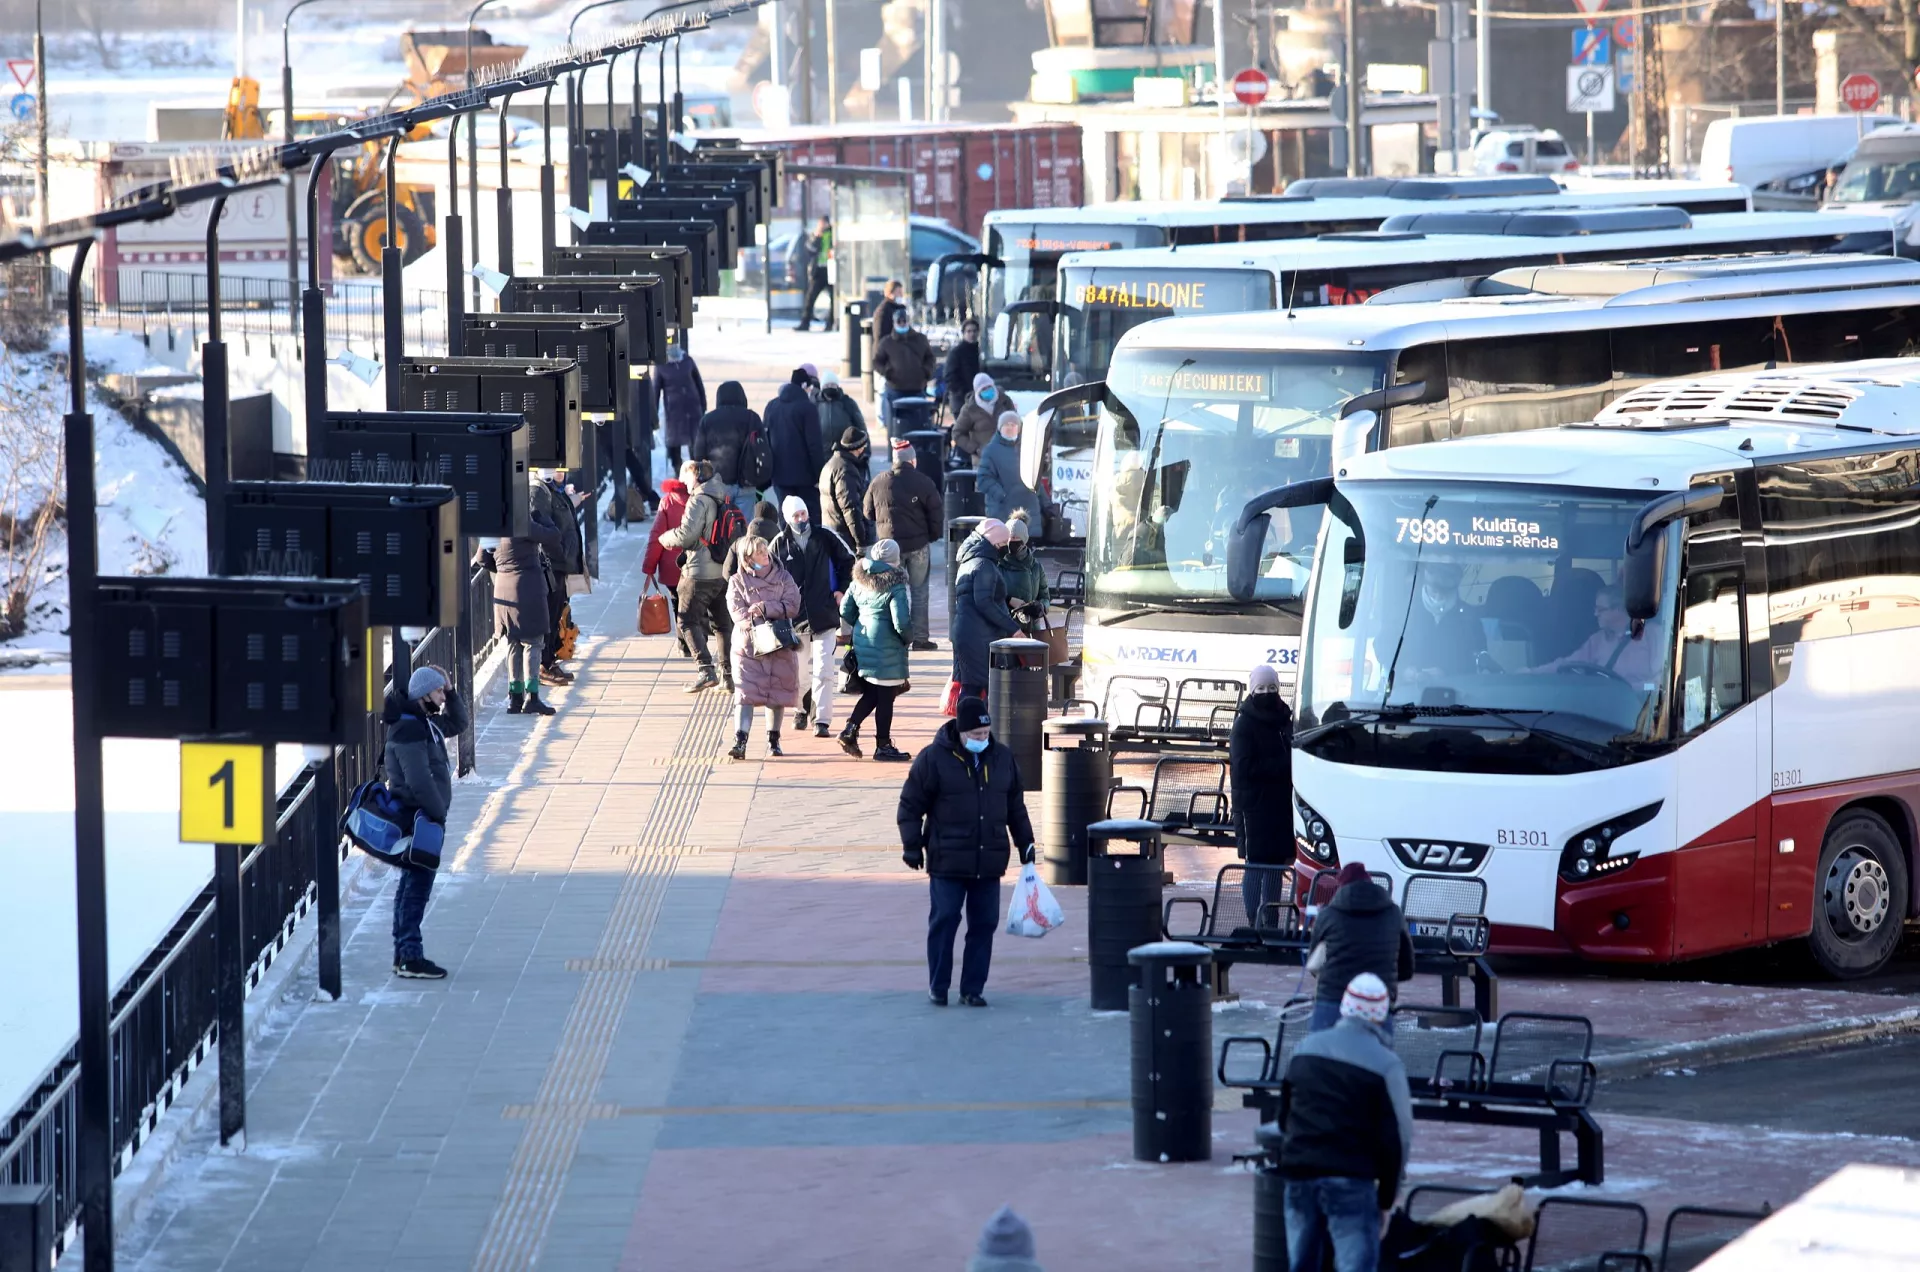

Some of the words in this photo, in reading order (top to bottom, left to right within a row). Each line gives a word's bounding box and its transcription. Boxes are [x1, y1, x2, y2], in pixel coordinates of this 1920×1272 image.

[1844, 83, 1876, 102] STOP
[1396, 517, 1449, 545] 7938
[1472, 516, 1540, 536] Kuldīga
[1452, 532, 1559, 549] Tukums-Renda
[1773, 768, 1803, 788] B1301
[209, 759, 234, 828] 1
[1497, 829, 1549, 847] B1301
[1400, 842, 1473, 867] VDL
